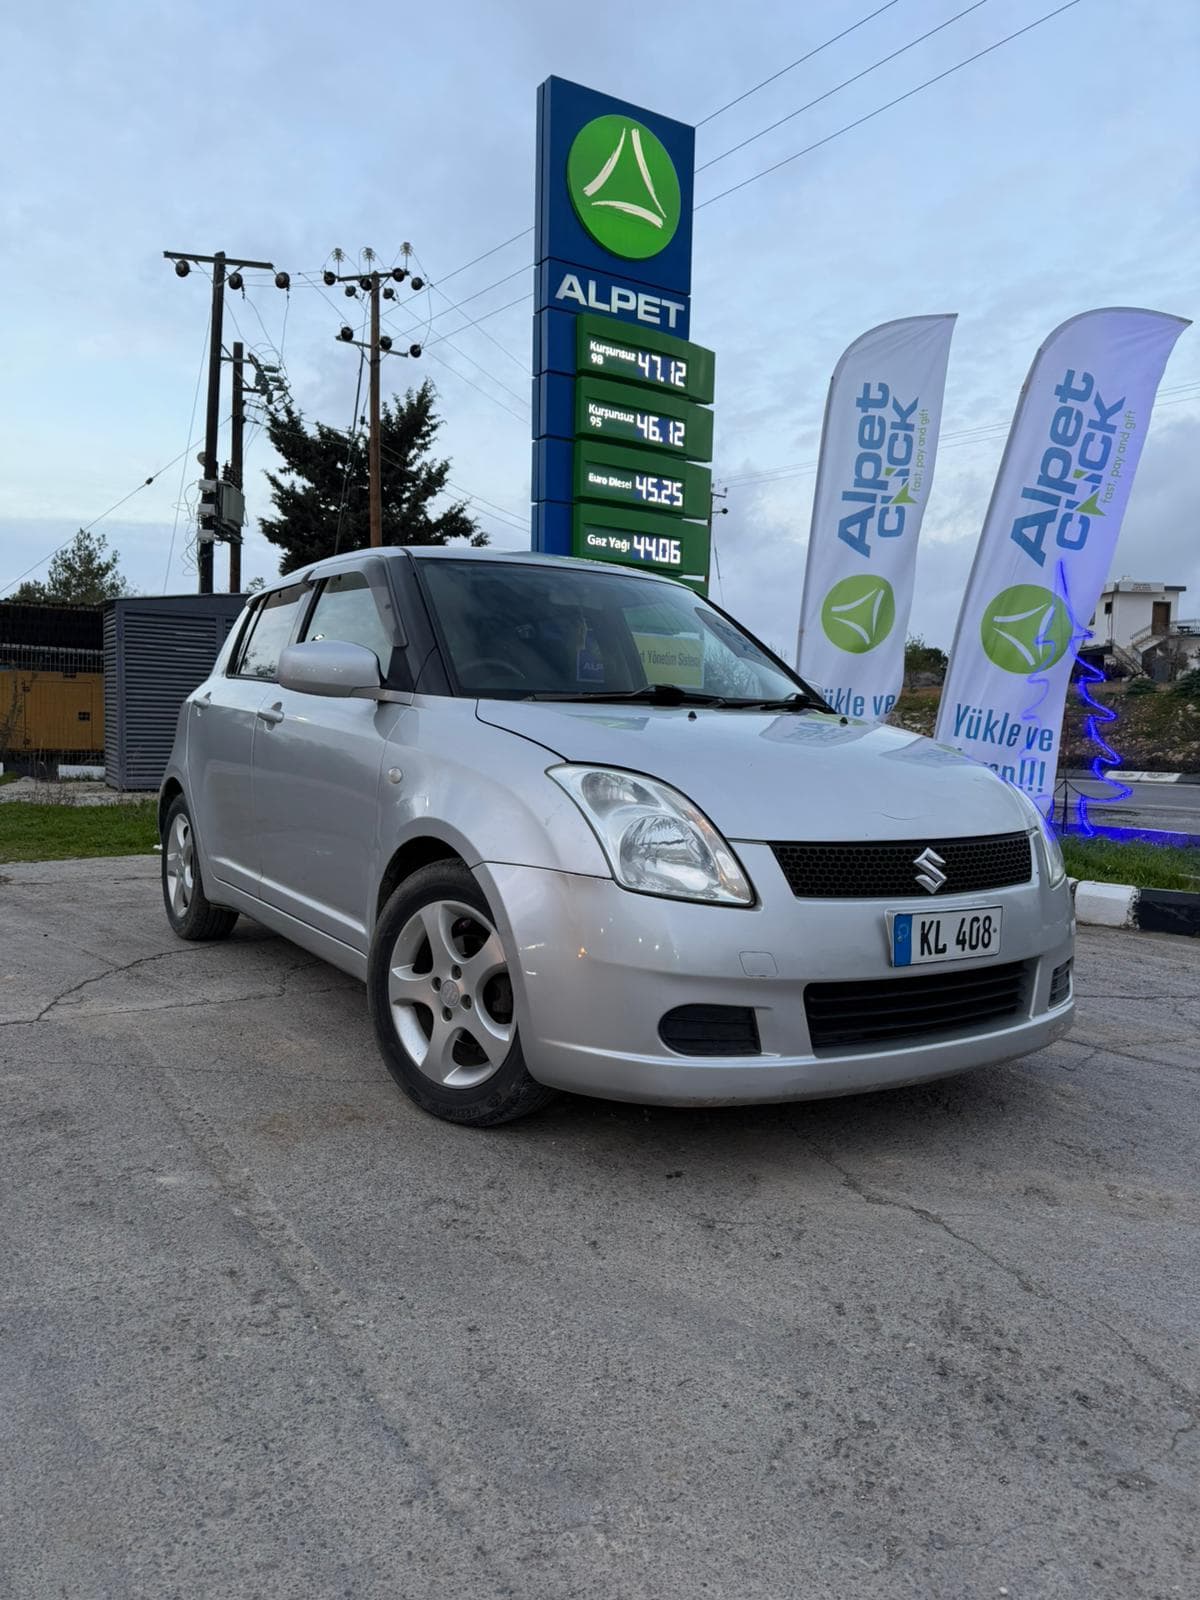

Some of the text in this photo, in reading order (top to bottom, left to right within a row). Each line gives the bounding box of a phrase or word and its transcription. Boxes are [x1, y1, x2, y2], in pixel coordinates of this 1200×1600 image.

[555, 273, 685, 328] ALPET
[589, 340, 637, 362] Kurşunsuz
[590, 353, 604, 365] 98
[638, 352, 687, 387] 47.12
[588, 403, 635, 424] Kurşunsuz
[590, 415, 602, 428] 95
[919, 409, 930, 425] gift
[1124, 410, 1137, 430] gift
[637, 413, 685, 447] 46.12
[918, 427, 926, 447] and
[1118, 431, 1131, 454] and
[917, 449, 927, 468] pay
[1010, 368, 1095, 568] Alpet
[1111, 456, 1126, 478] pay
[588, 472, 632, 489] Euro Diesel
[838, 382, 890, 559] Alpet
[635, 475, 683, 507] 45.25
[587, 534, 630, 552] Gaz Yağı
[633, 535, 681, 564] 44.06
[823, 687, 896, 717] ükle ve
[953, 703, 1054, 752] Yükle ve
[920, 915, 993, 956] KL 408
